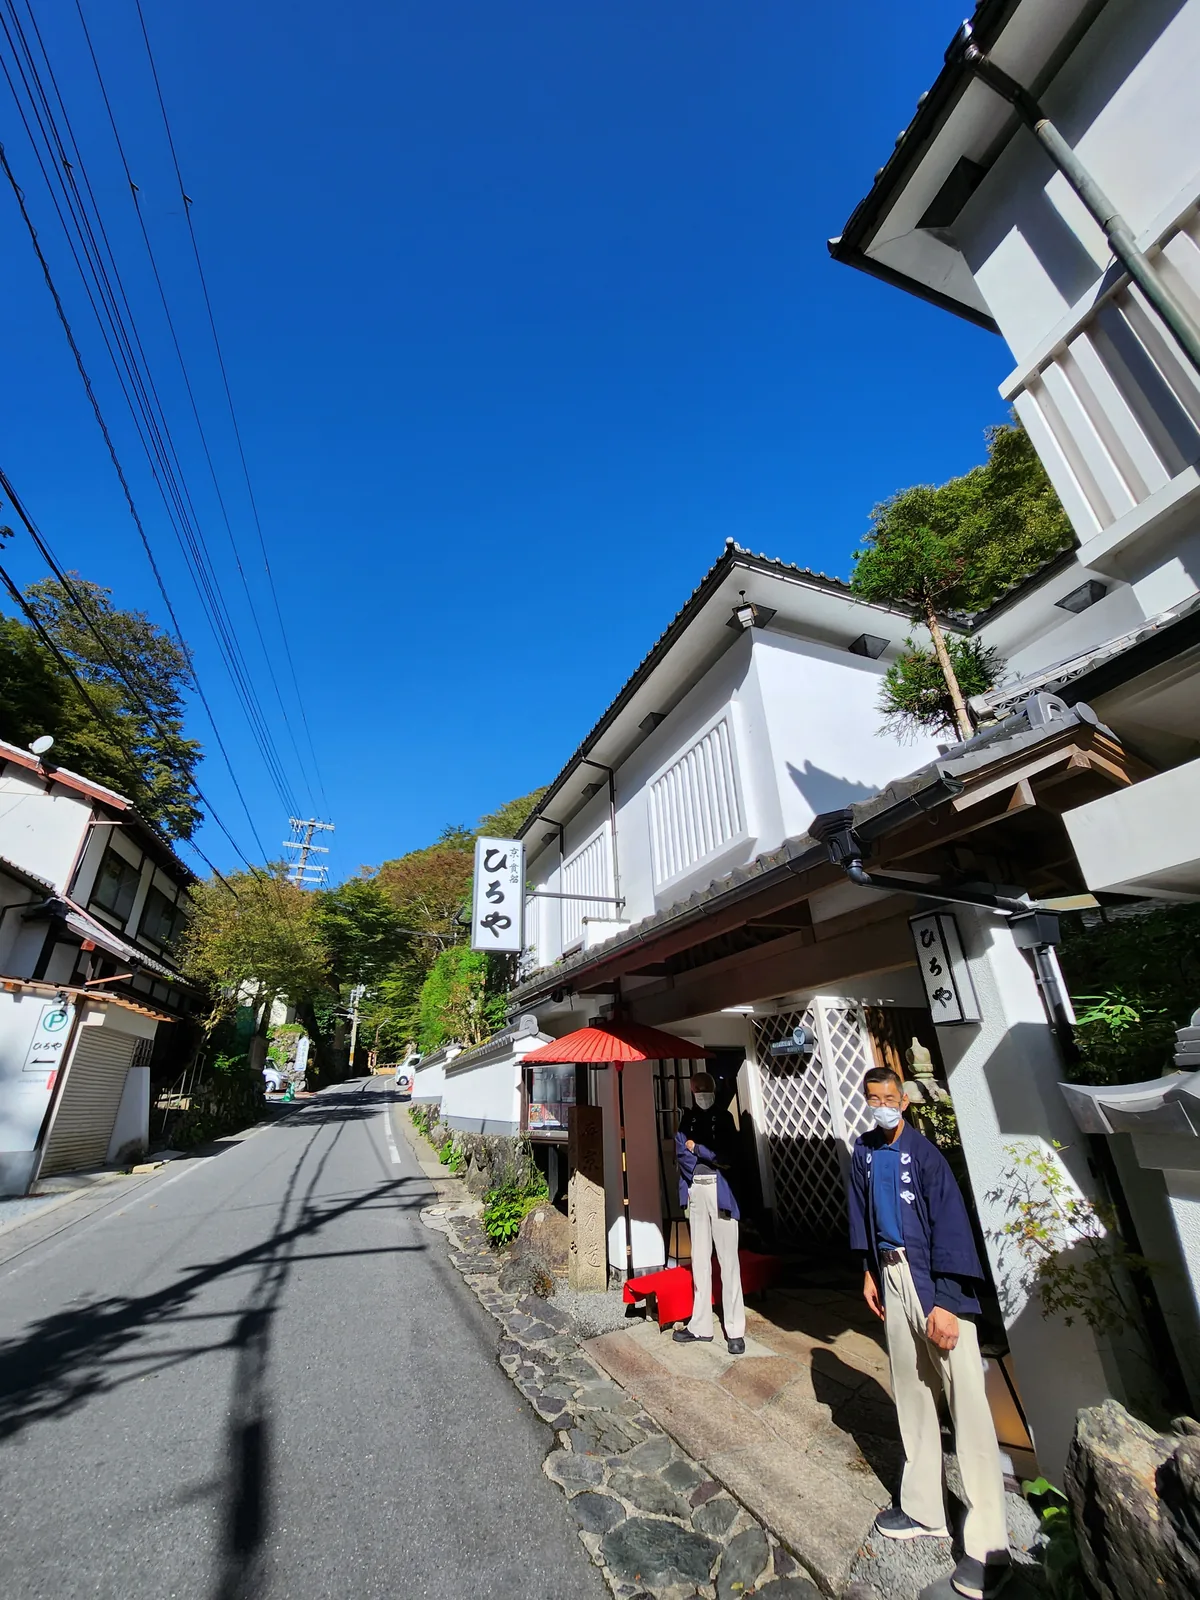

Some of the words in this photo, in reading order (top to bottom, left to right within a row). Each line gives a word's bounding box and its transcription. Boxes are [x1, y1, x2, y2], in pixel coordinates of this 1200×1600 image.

[480, 848, 512, 939] ひろや
[920, 928, 953, 1008] ひろや
[32, 1042, 63, 1051] ひろや
[49, 1014, 65, 1028] P
[900, 1152, 916, 1205] ひろや
